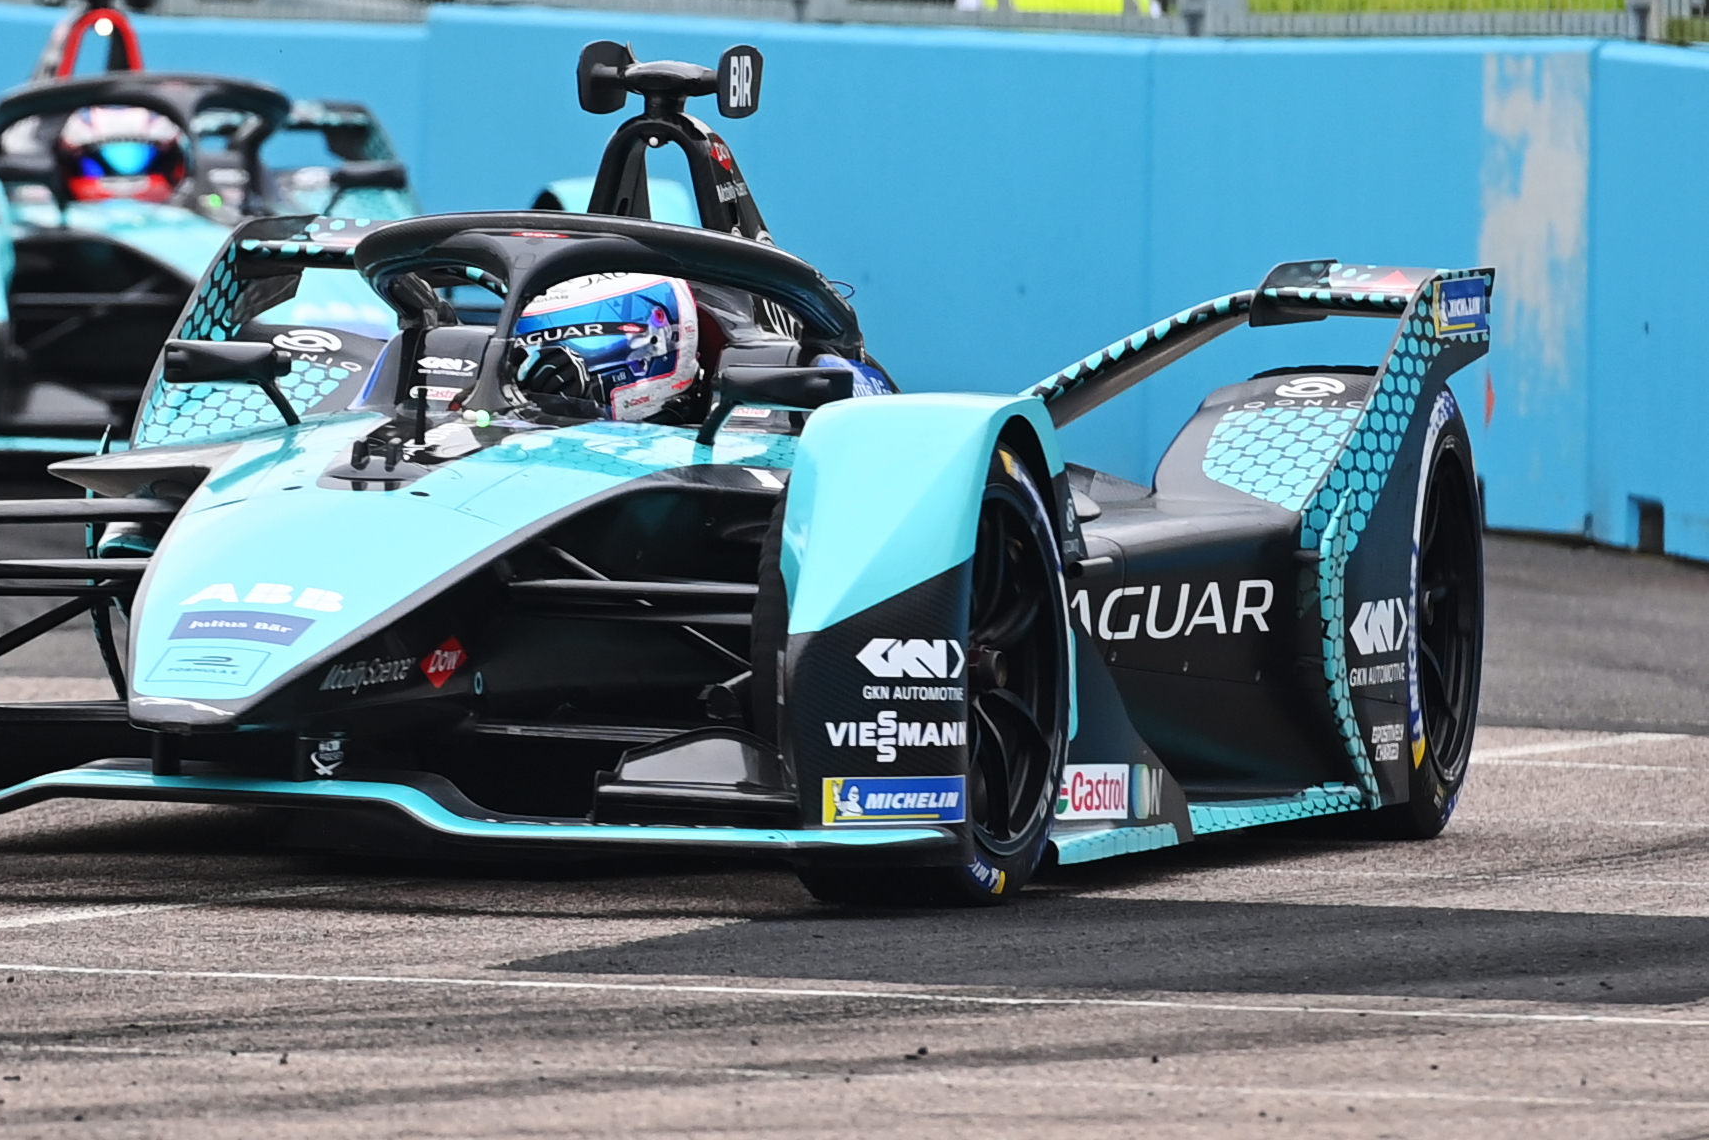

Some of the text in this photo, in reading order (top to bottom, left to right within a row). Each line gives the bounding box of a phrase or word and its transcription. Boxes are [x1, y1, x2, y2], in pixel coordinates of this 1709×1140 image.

[512, 323, 604, 349] AGUAR
[179, 582, 344, 613] ABB
[1070, 579, 1274, 641] AGUAR
[189, 619, 248, 630] Julius
[862, 685, 890, 700] GKN
[864, 791, 959, 810] MICHELIN
[1071, 771, 1126, 812] Castrol
